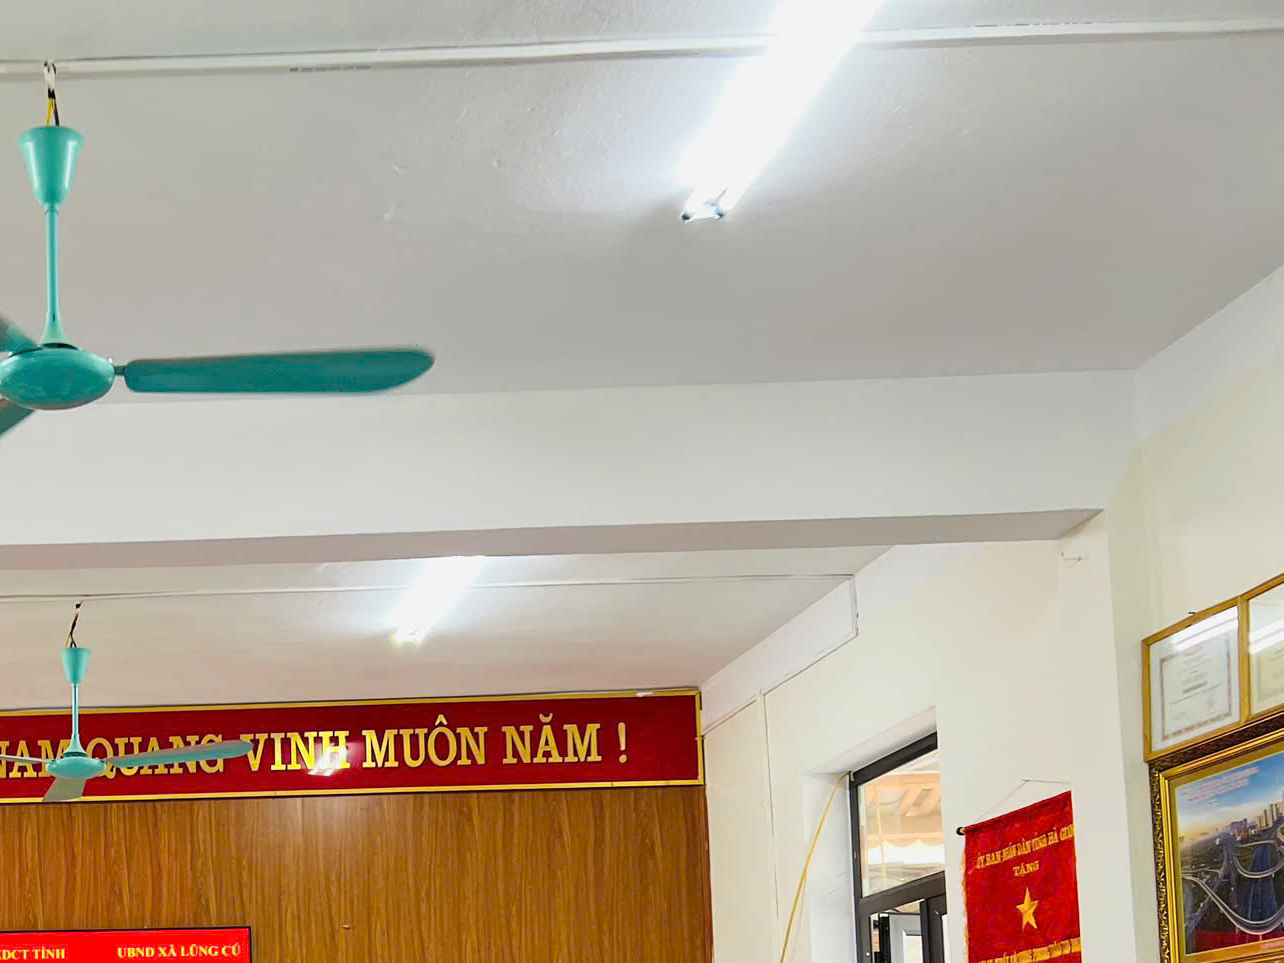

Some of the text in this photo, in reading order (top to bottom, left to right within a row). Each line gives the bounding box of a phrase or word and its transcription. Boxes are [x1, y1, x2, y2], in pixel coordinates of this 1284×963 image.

[239, 731, 351, 772] VINH
[362, 714, 488, 768] MUÔN
[502, 713, 602, 764] NĂM
[618, 722, 627, 764] !
[32, 945, 65, 960] TỈNH
[117, 942, 241, 958] UBND XÃ LŨNG CÚ
